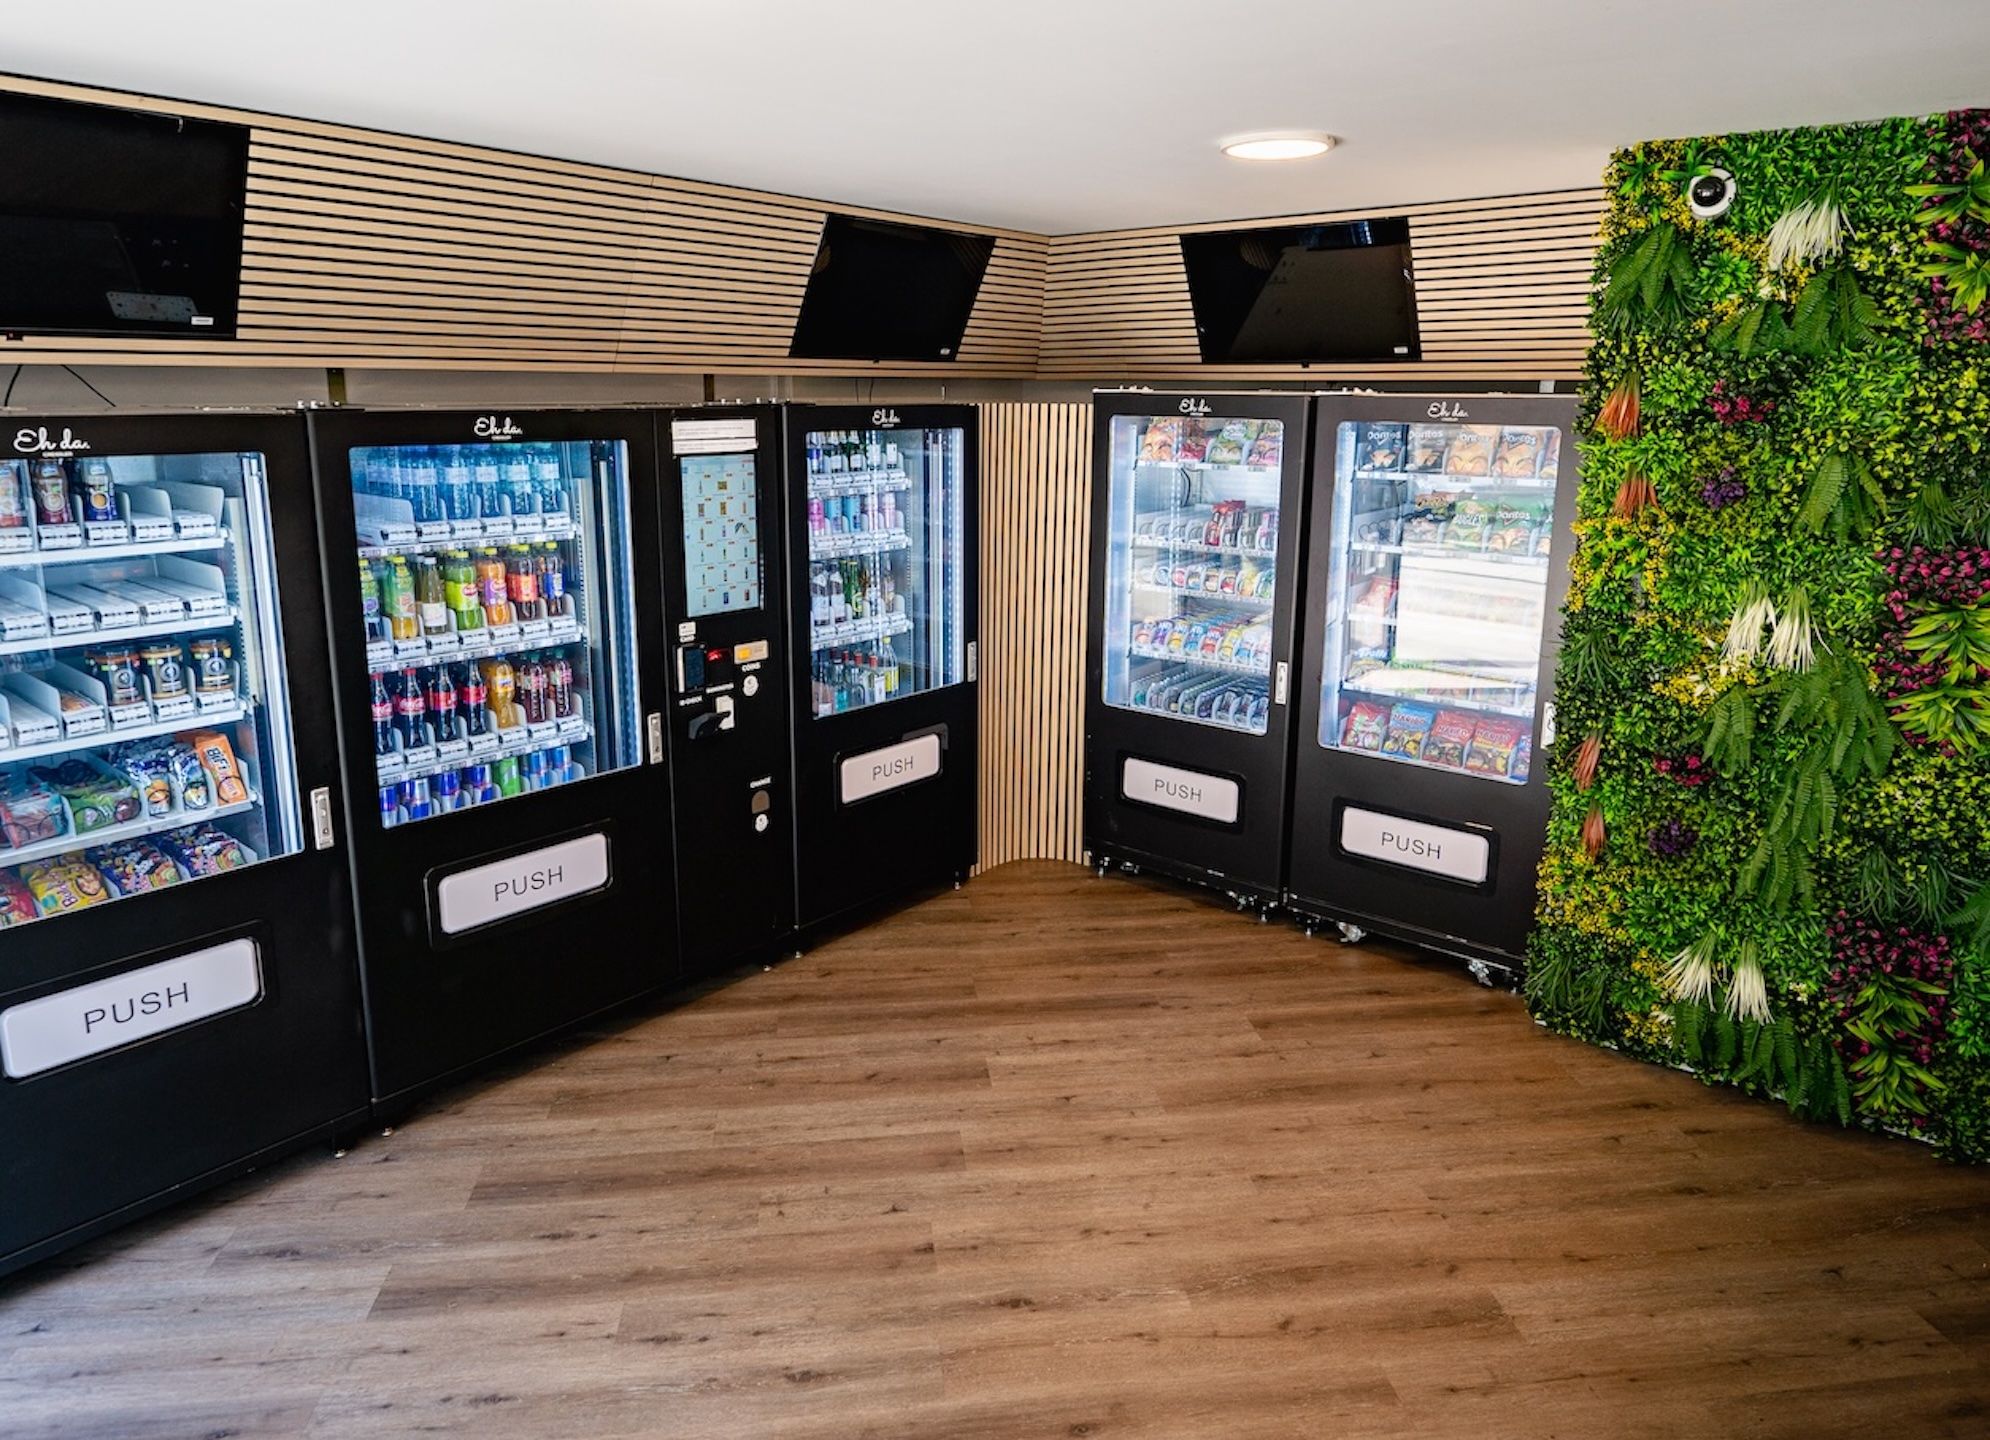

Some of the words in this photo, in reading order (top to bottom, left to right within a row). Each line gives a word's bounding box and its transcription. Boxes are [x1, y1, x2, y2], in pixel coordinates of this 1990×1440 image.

[473, 415, 502, 437] Eh
[1367, 430, 1402, 441] Doritos
[1408, 430, 1444, 441] Doritos
[13, 426, 57, 453] Eh
[872, 756, 914, 782] PUSH
[1154, 779, 1202, 801] PUSH
[1381, 831, 1443, 861] PUSH
[494, 865, 564, 902] PUSH
[83, 982, 190, 1035] PUSH
